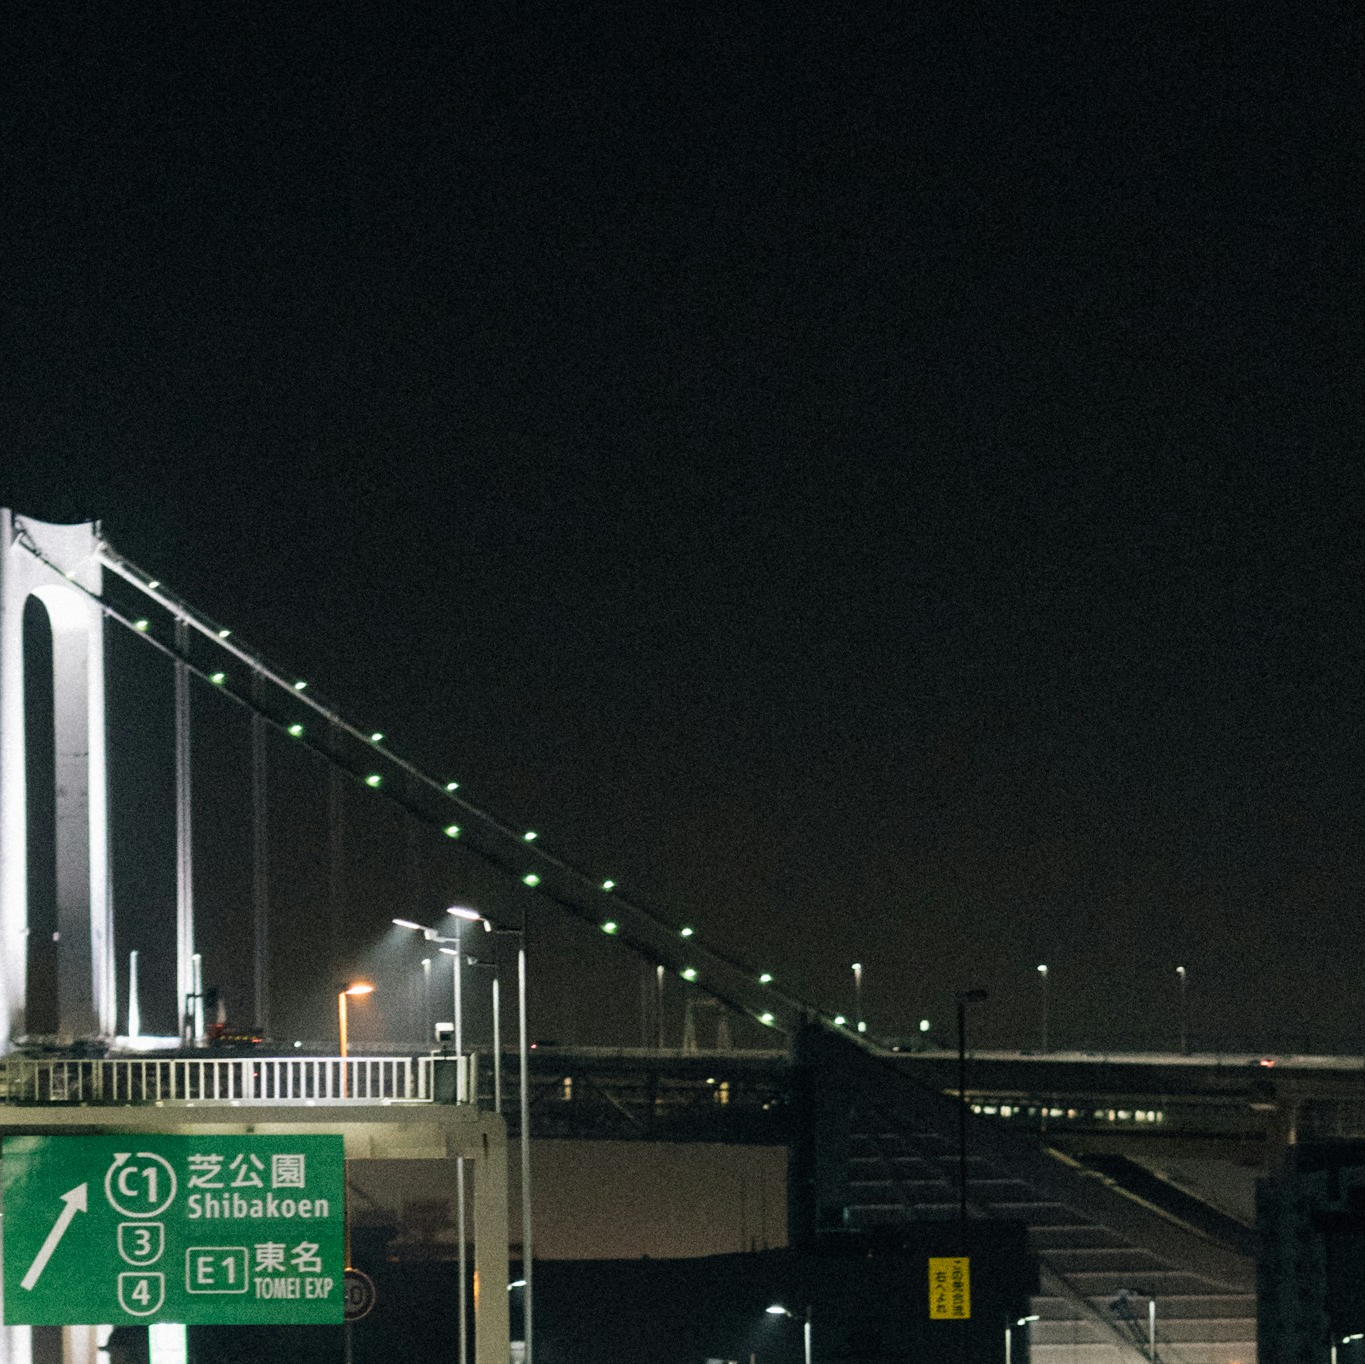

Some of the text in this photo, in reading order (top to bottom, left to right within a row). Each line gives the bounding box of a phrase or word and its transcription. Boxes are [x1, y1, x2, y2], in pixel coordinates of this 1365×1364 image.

[118, 1167, 159, 1202] C1
[187, 1153, 306, 1189] 芝公園
[188, 1193, 330, 1219] Shibakoen
[133, 1229, 151, 1256] 3
[196, 1256, 236, 1285] E1
[254, 1241, 323, 1273] 東名
[131, 1280, 151, 1305] 4
[254, 1277, 334, 1299] TOMEI EXP
